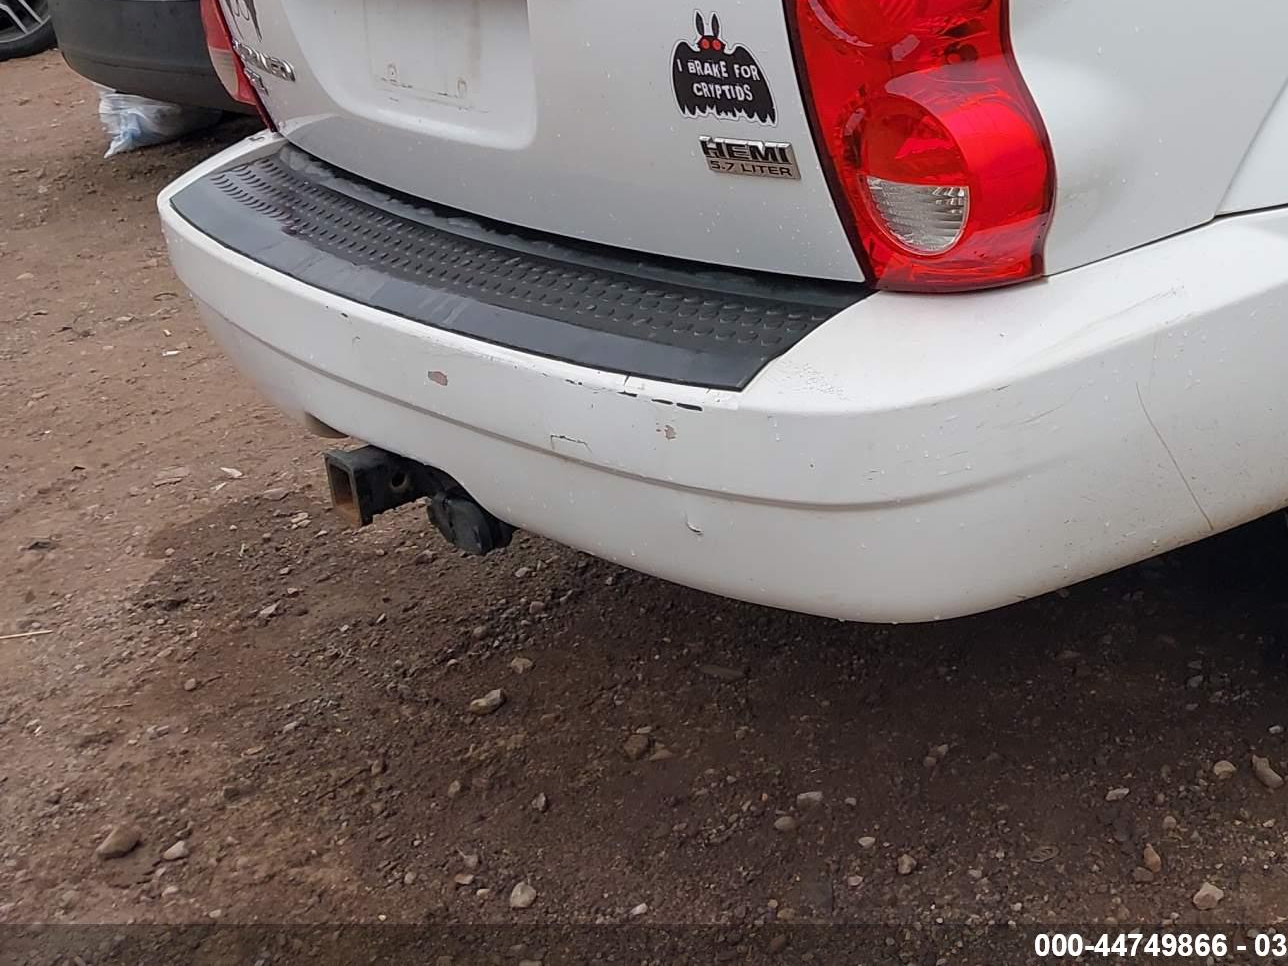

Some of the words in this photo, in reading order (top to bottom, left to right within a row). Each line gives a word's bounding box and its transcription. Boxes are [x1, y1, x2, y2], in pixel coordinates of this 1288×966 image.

[676, 59, 683, 72] I
[687, 59, 729, 78] BRAKE
[733, 64, 761, 81] FOR
[692, 82, 753, 101] CRYPTIDS
[699, 135, 793, 165] HEMI
[710, 160, 735, 172] 5.7
[741, 163, 793, 177] LITER
